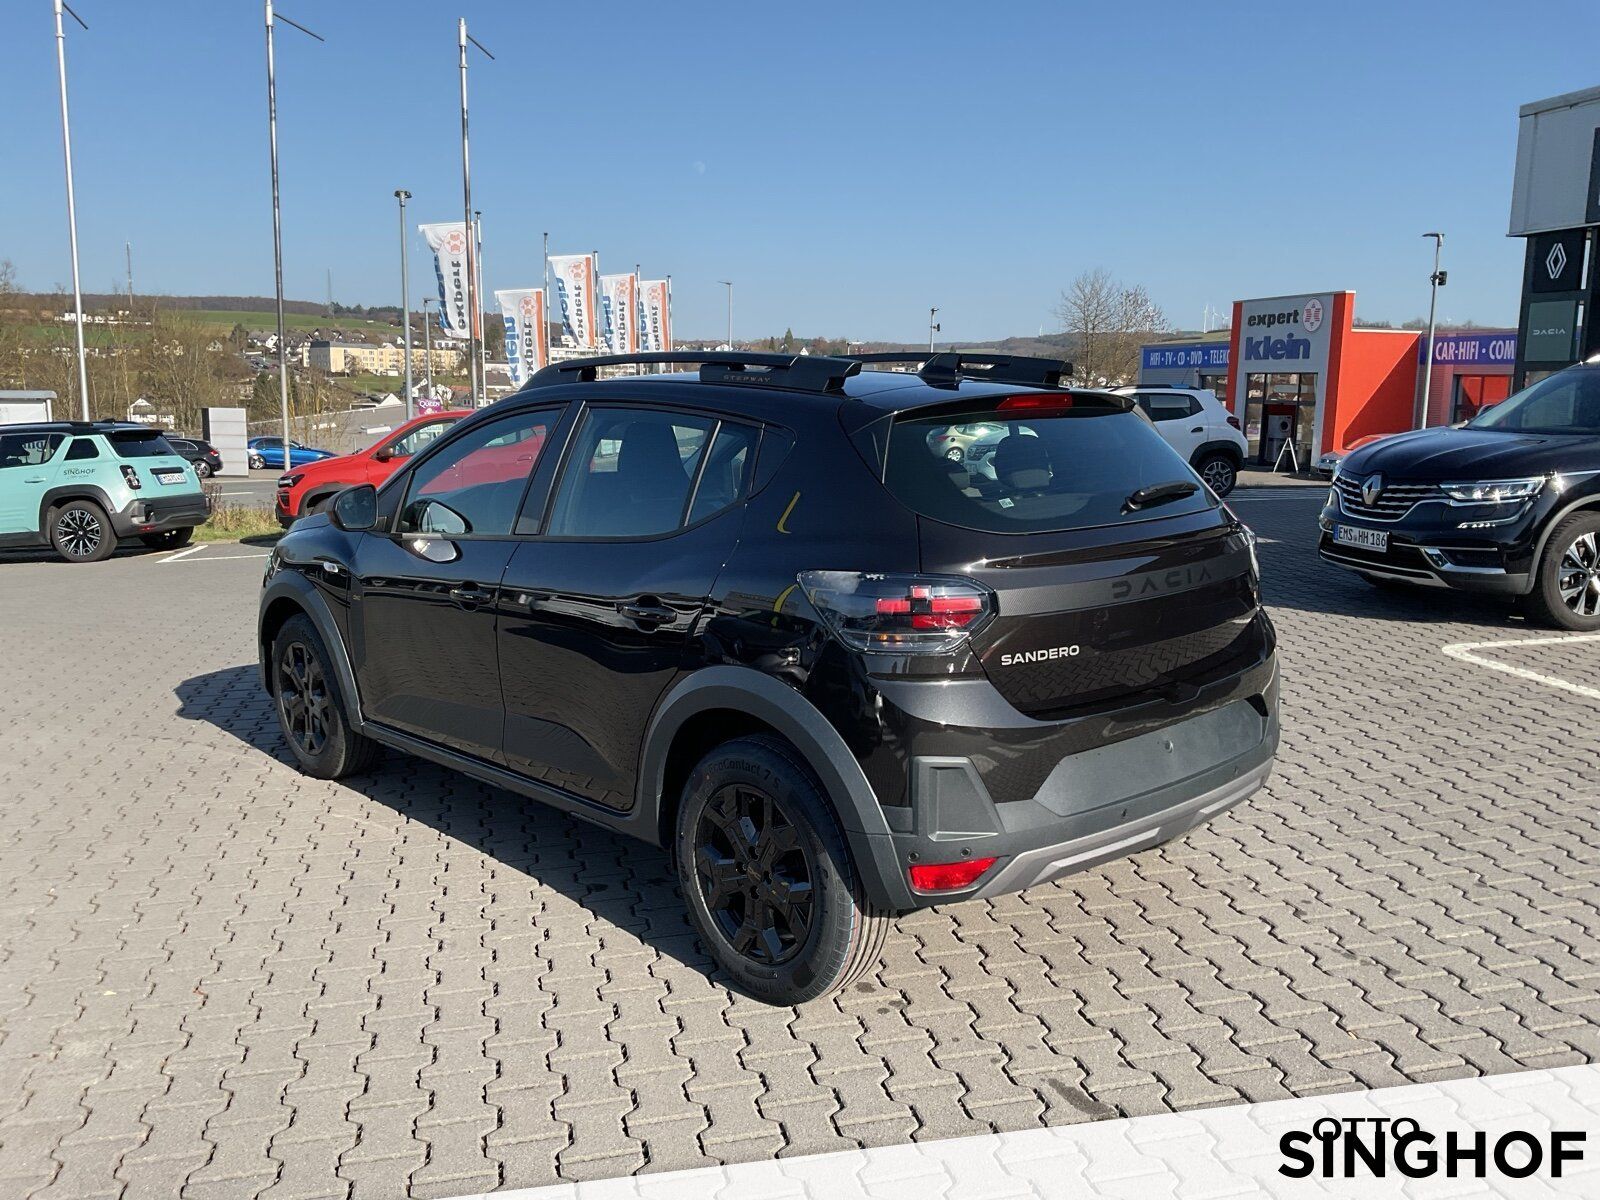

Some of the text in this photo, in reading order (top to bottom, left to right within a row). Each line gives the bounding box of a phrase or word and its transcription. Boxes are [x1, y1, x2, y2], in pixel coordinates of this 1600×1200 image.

[1247, 309, 1299, 328] expert
[1533, 328, 1566, 336] DACIA
[1245, 332, 1311, 360] klein
[1435, 340, 1515, 360] CAR-HIFI COM
[1149, 352, 1160, 366] HIFI
[1165, 351, 1173, 366] TV
[1177, 351, 1186, 365] CD
[1190, 350, 1203, 365] DVD
[723, 374, 771, 383] STEPWAY
[63, 468, 96, 476] SINGHOF
[1338, 526, 1386, 547] EMS HH 186
[1112, 566, 1212, 599] DACIA
[1000, 644, 1080, 666] SANDERO
